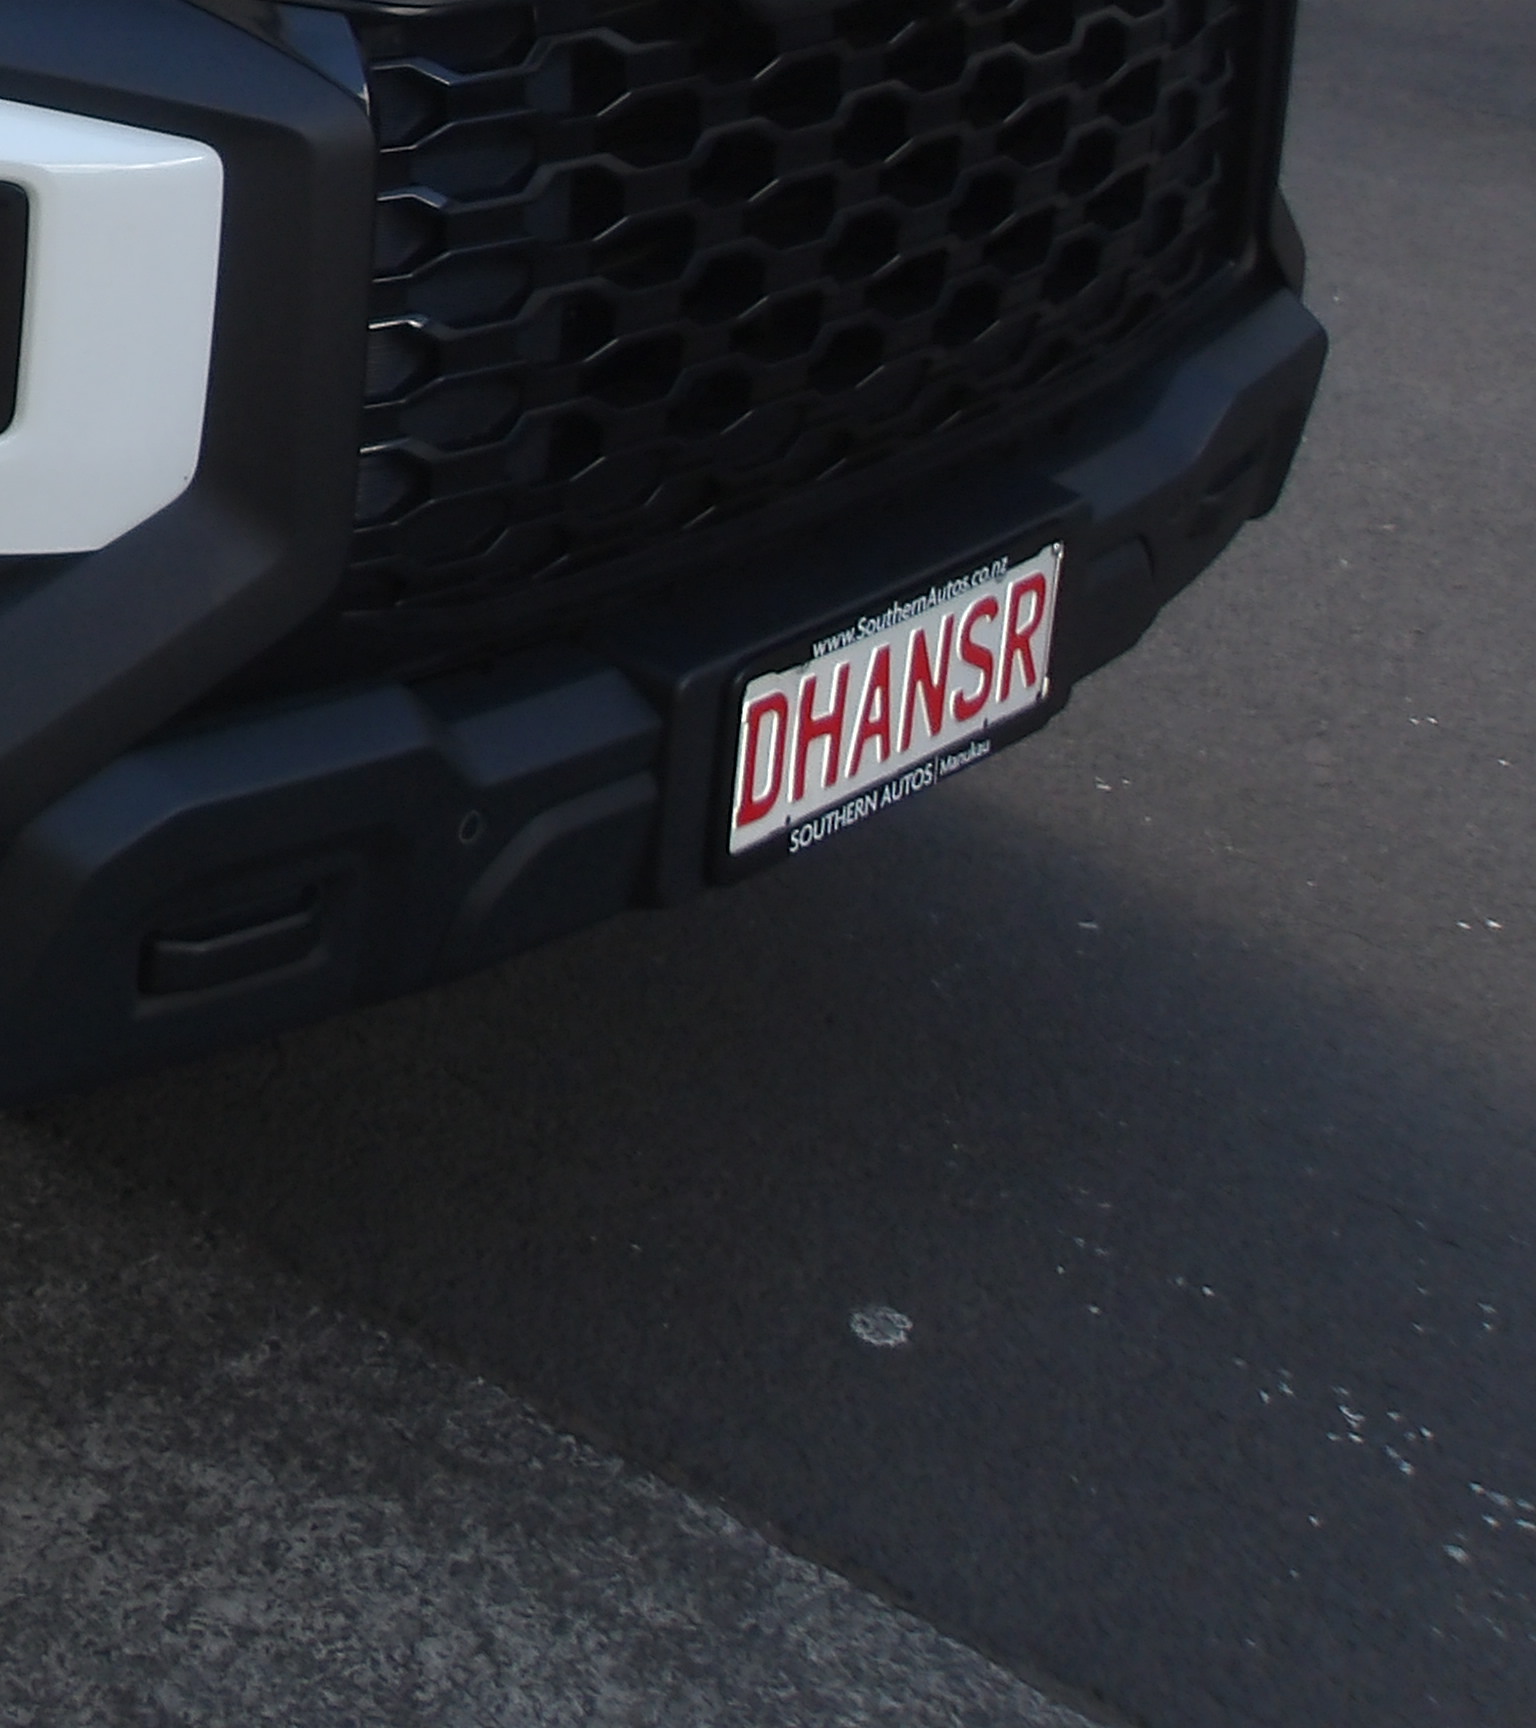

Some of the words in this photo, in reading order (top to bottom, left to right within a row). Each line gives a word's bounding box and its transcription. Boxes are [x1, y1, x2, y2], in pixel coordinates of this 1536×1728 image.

[812, 556, 1008, 659] www.SouthernAutos.co.nz
[736, 570, 1047, 828] DHANSR
[788, 790, 878, 853] SOUTHERN
[880, 761, 934, 809] AUTOS
[938, 738, 991, 776] Manukau
